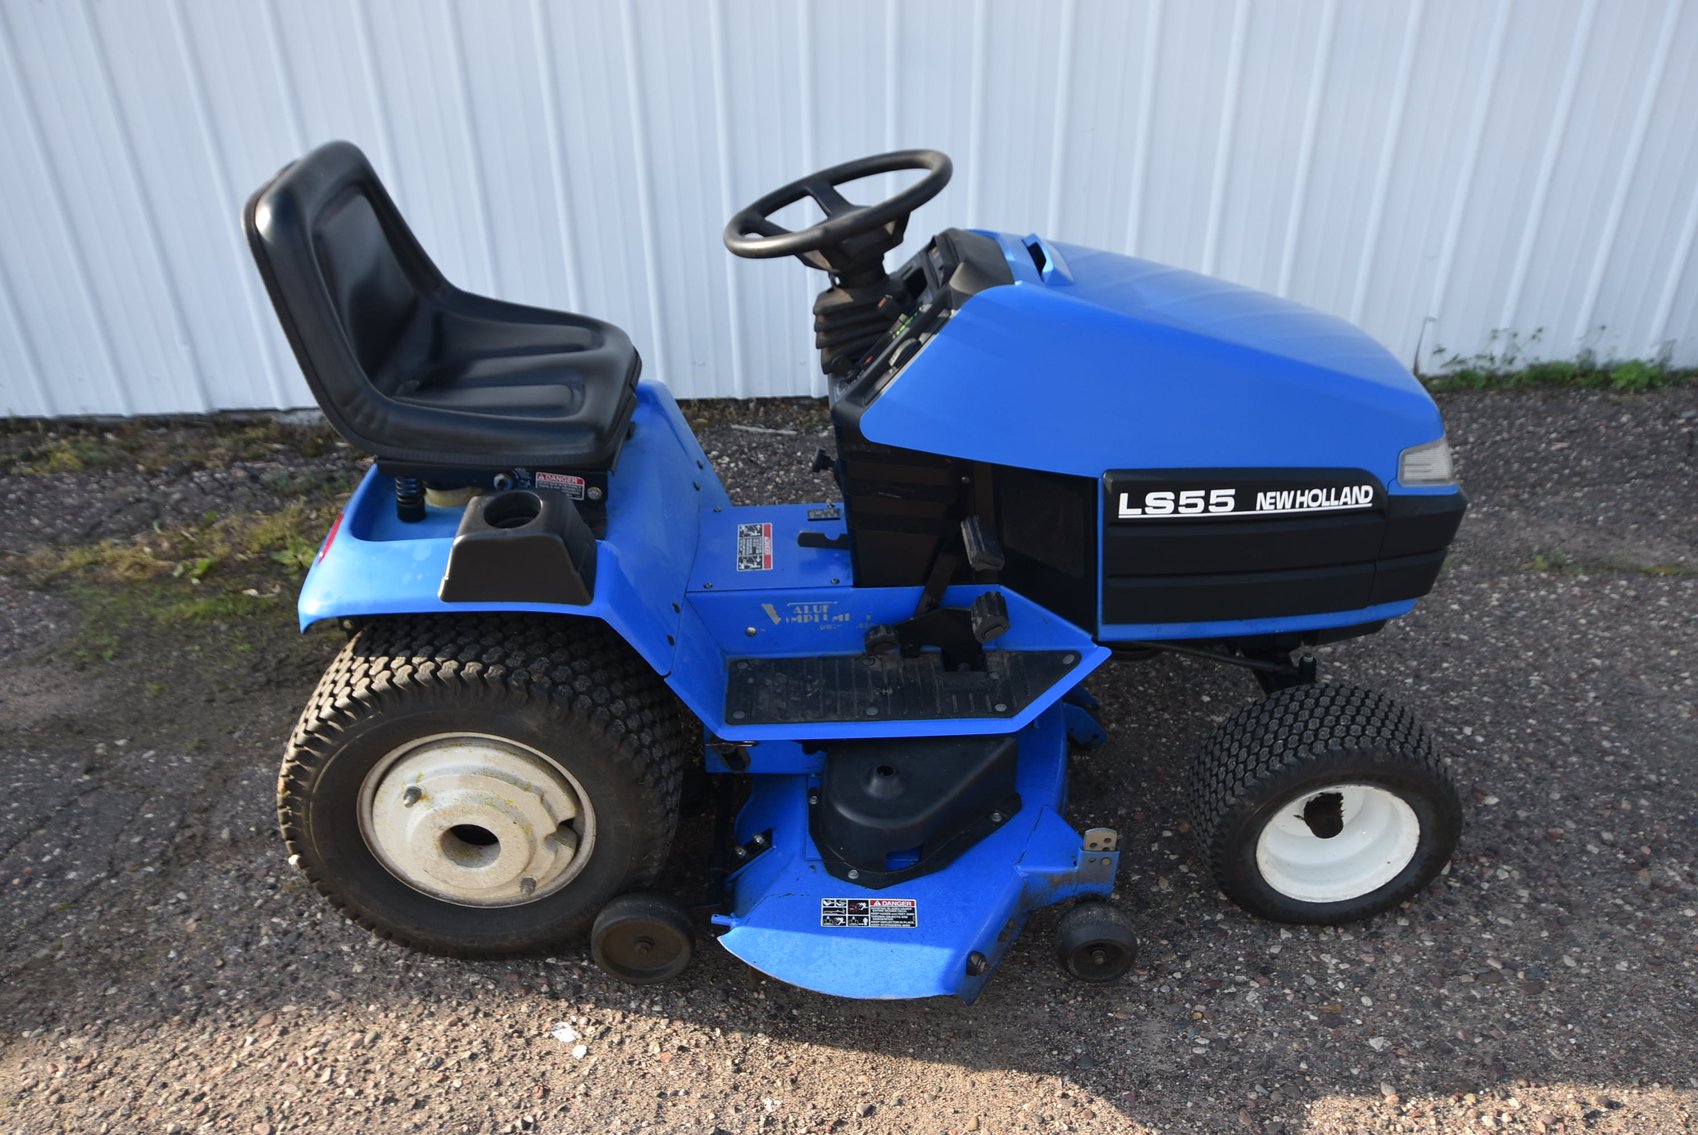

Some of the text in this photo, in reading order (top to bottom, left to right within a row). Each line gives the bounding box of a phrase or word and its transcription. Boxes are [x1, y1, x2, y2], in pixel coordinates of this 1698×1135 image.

[545, 474, 578, 484] DANGER
[1118, 485, 1374, 515] LS55 NEW HOLLAND
